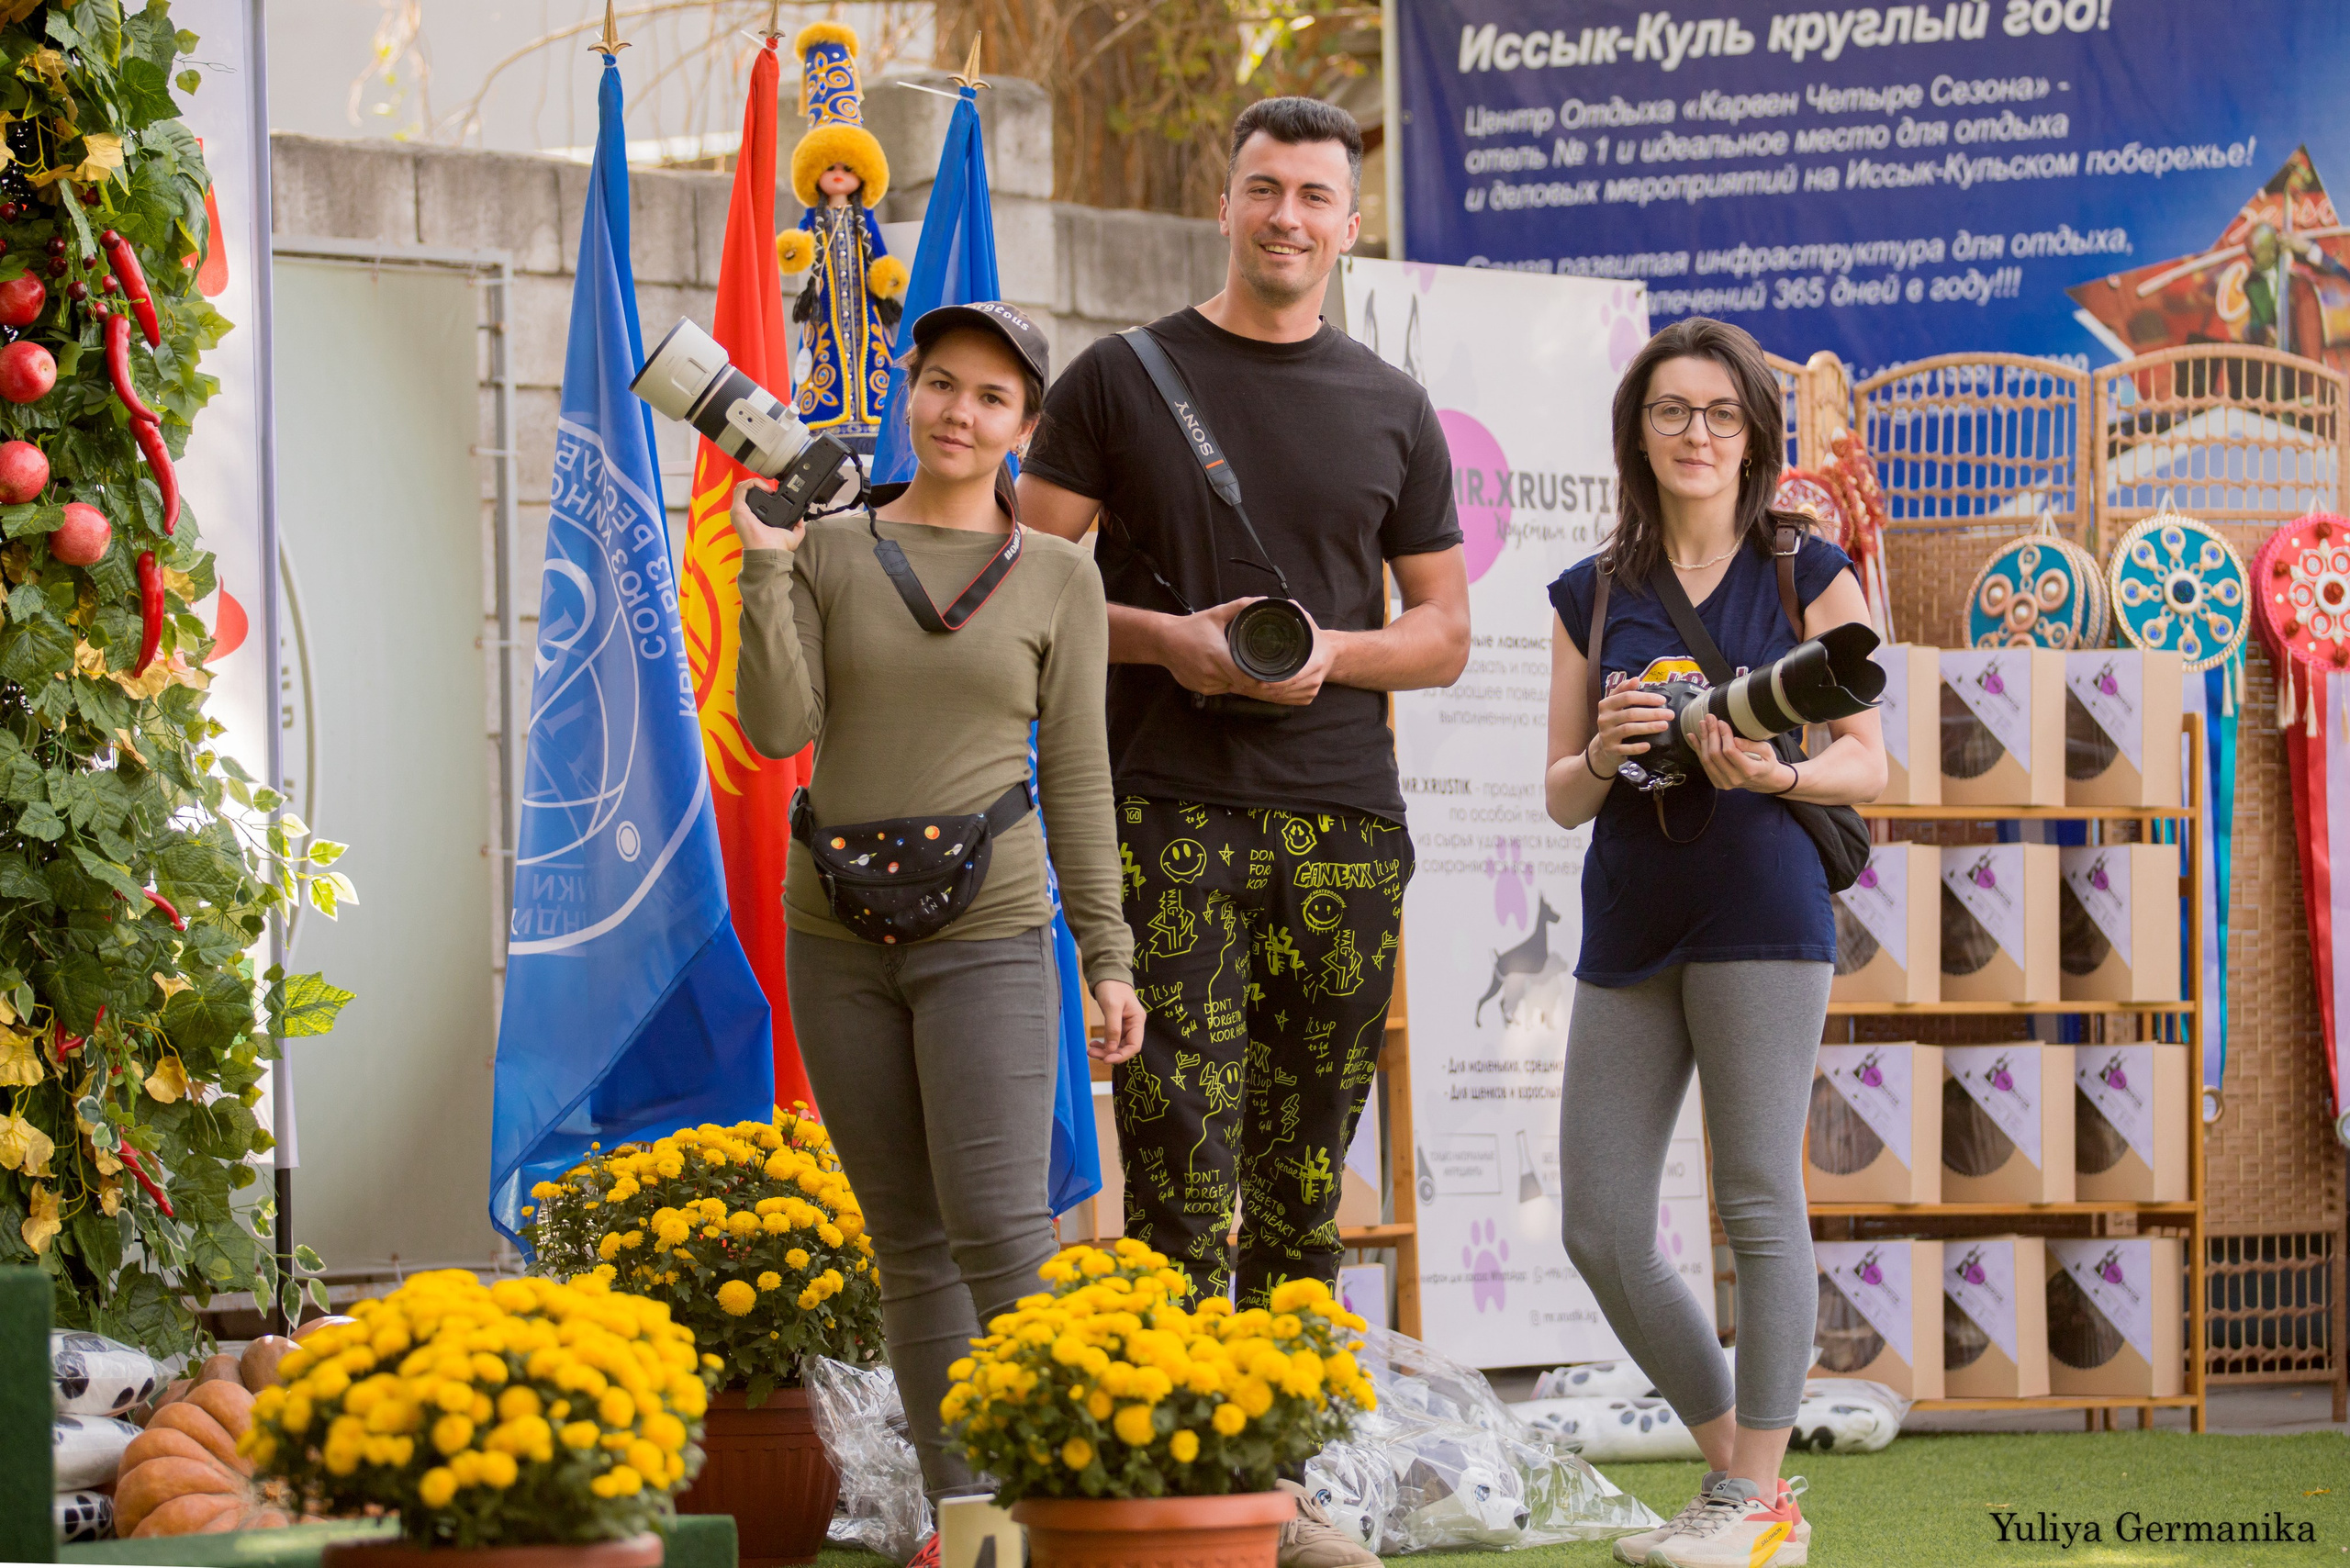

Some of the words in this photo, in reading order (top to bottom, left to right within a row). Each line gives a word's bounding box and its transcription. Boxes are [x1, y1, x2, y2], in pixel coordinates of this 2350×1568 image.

[1459, 11, 1756, 73] Иссык-Куль
[1768, 0, 1990, 62] круглый
[1465, 100, 1555, 138] Центр
[1561, 95, 1676, 130] Отдыха
[1805, 81, 1923, 117] Четыре
[1930, 73, 2051, 106] Сезона»
[1464, 140, 1549, 174] отель
[1615, 139, 1637, 165] и
[1640, 129, 1790, 163] идеальное
[1794, 124, 1891, 155] место
[1896, 117, 1948, 149] для
[1953, 108, 2070, 145] отдыха
[1464, 186, 1486, 212] и
[1488, 174, 1599, 211] деловых
[1604, 163, 1799, 207] мероприятий
[1804, 165, 1840, 194] на
[1844, 150, 2079, 191] Иссык-Кульском
[2085, 136, 2257, 178] побережье!
[1695, 235, 1945, 280] инфраструктура
[1953, 230, 2003, 261] для
[2011, 223, 2134, 259] отдыха,
[1773, 277, 1825, 310] 365
[1830, 269, 1898, 308] дней
[1905, 277, 1925, 303] в
[1174, 401, 1214, 456] SONY
[1004, 529, 1021, 561] Canon
[1761, 1526, 1783, 1547] SALOMON
